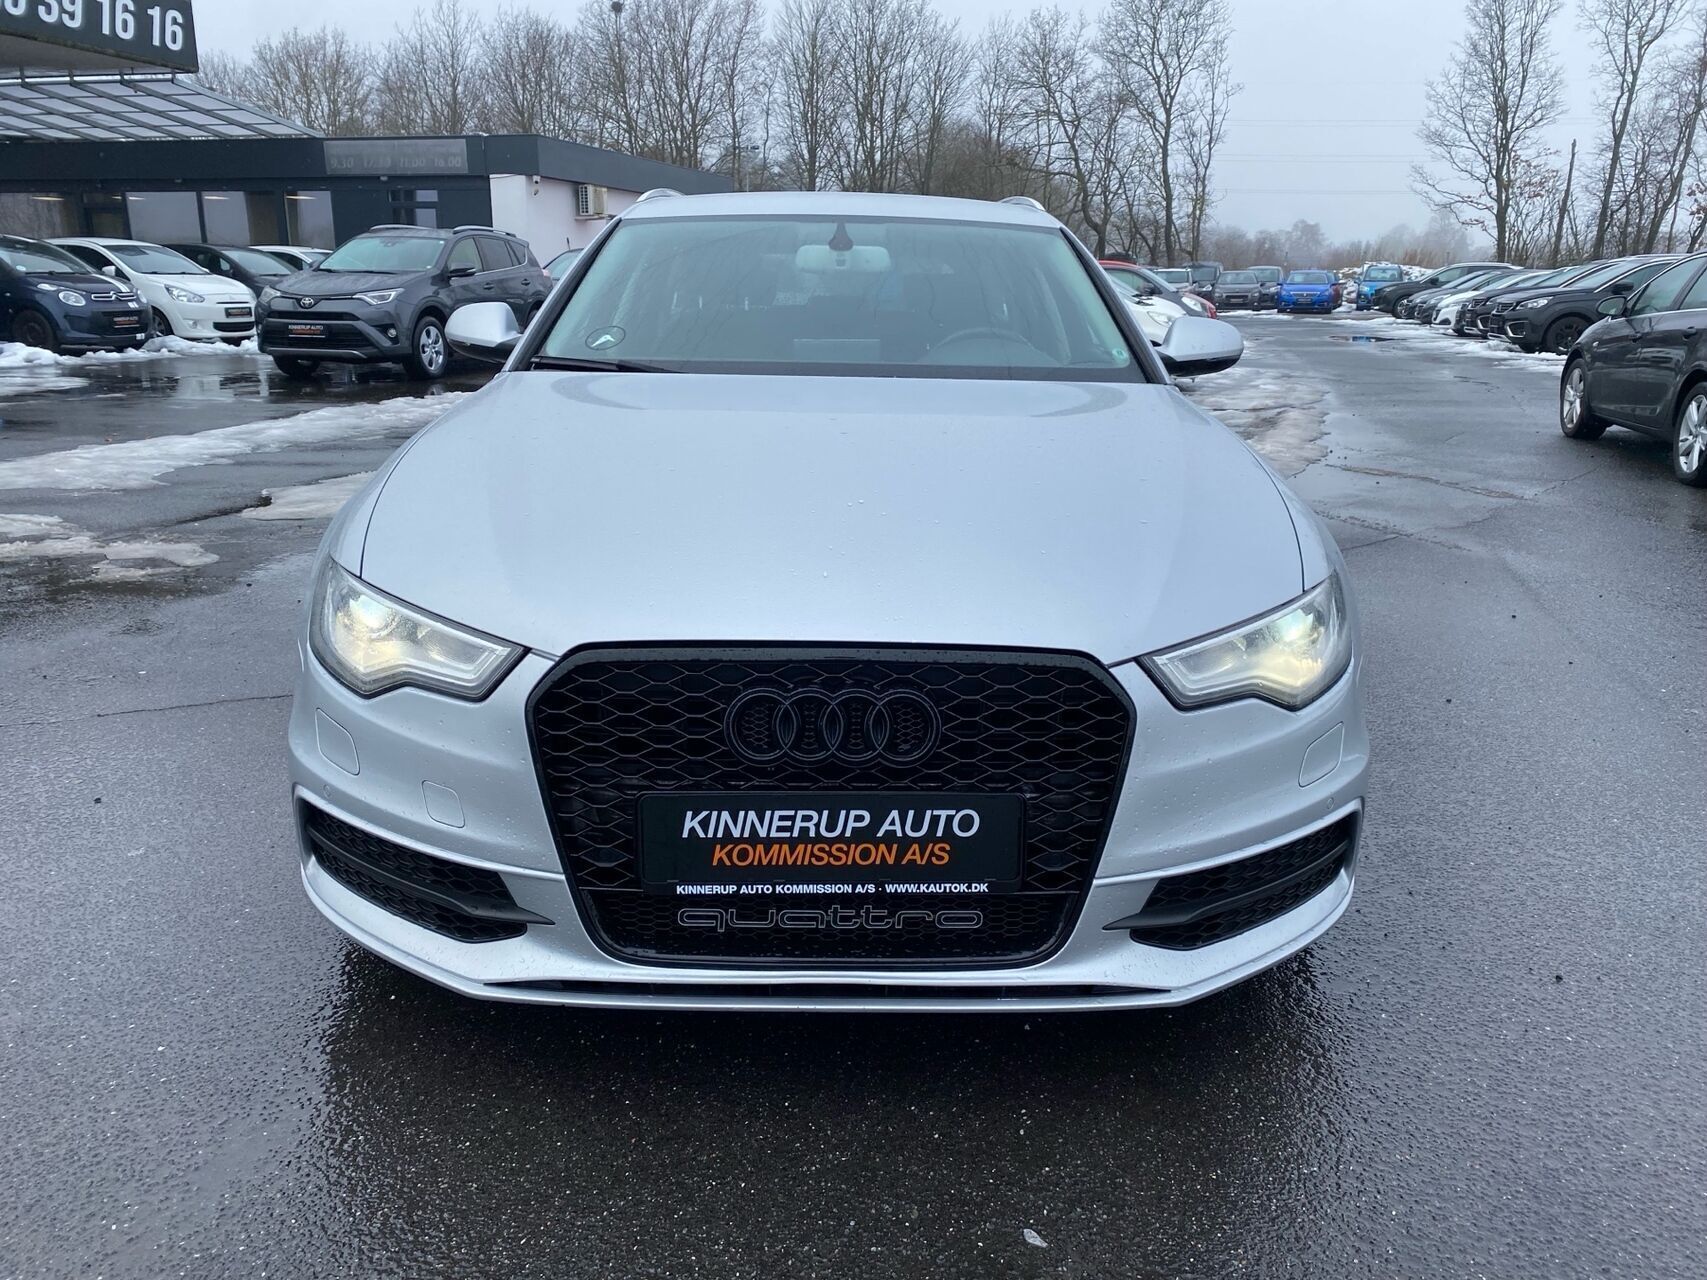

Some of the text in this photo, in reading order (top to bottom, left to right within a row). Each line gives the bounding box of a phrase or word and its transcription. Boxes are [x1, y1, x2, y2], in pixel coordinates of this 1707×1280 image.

[96, 0, 135, 40] 16
[147, 5, 184, 51] 16
[681, 809, 980, 838] KINNERUP AUTO
[712, 843, 951, 867] KOMMISSION A/S
[676, 883, 989, 895] KINNERUP AUTO KOMMISSION A/S WWW.KAUTOK.DK
[677, 905, 984, 932] quattro
